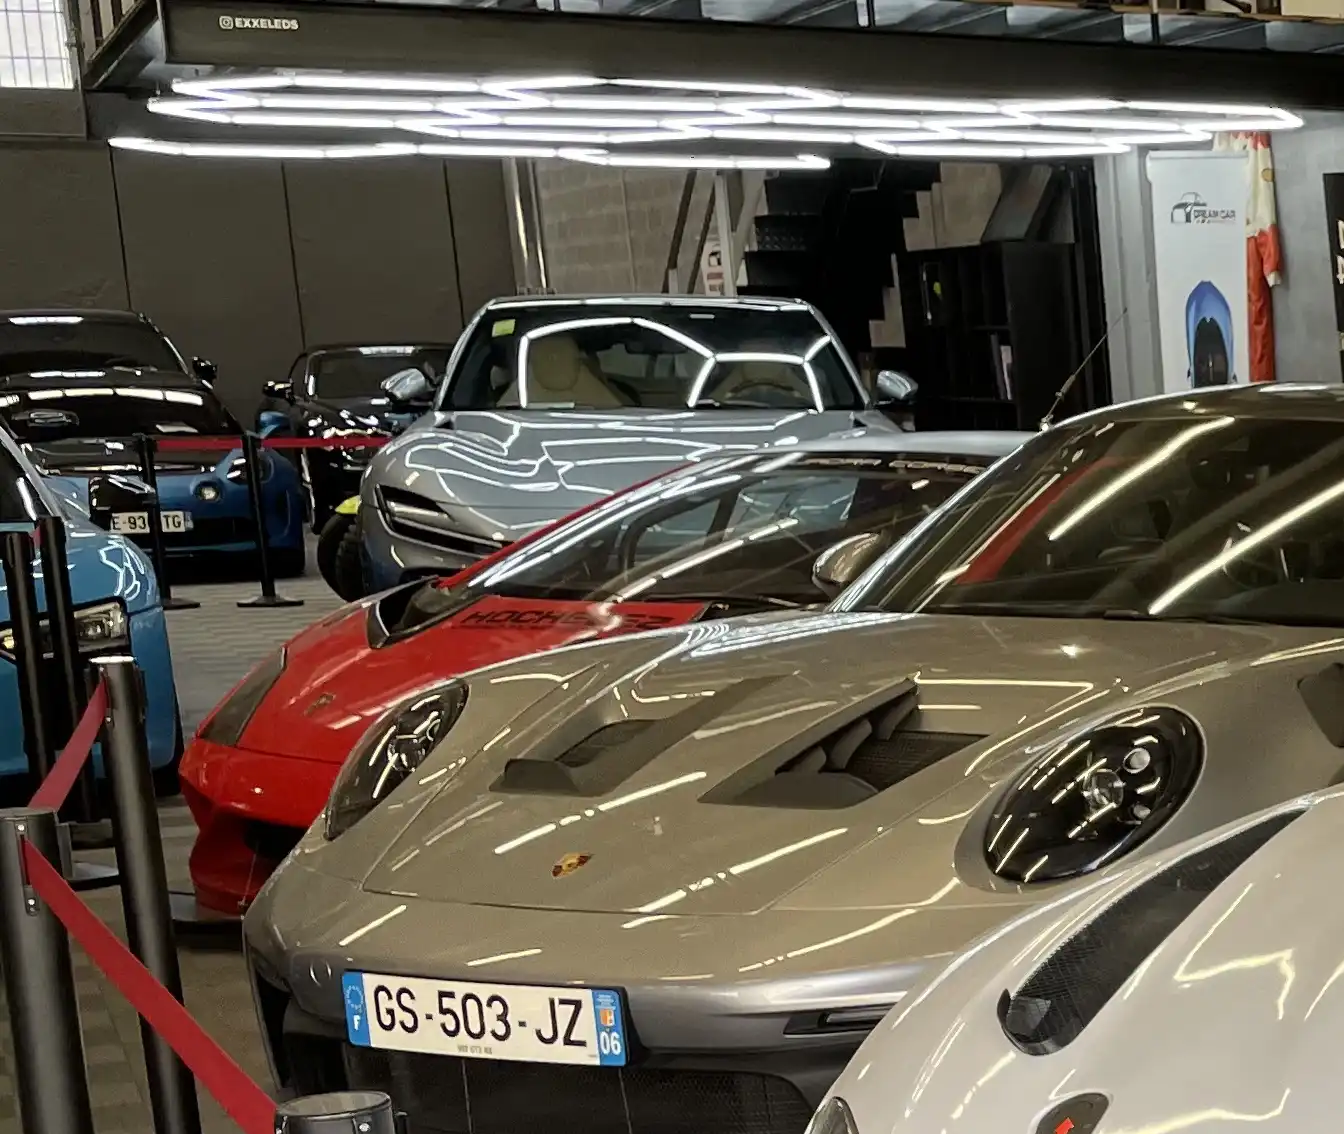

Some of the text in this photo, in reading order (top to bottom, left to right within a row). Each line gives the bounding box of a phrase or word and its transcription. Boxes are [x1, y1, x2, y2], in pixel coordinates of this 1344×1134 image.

[235, 18, 298, 29] EXXELEDS
[373, 984, 587, 1048] GS-503-JZ
[600, 1031, 621, 1055] 06
